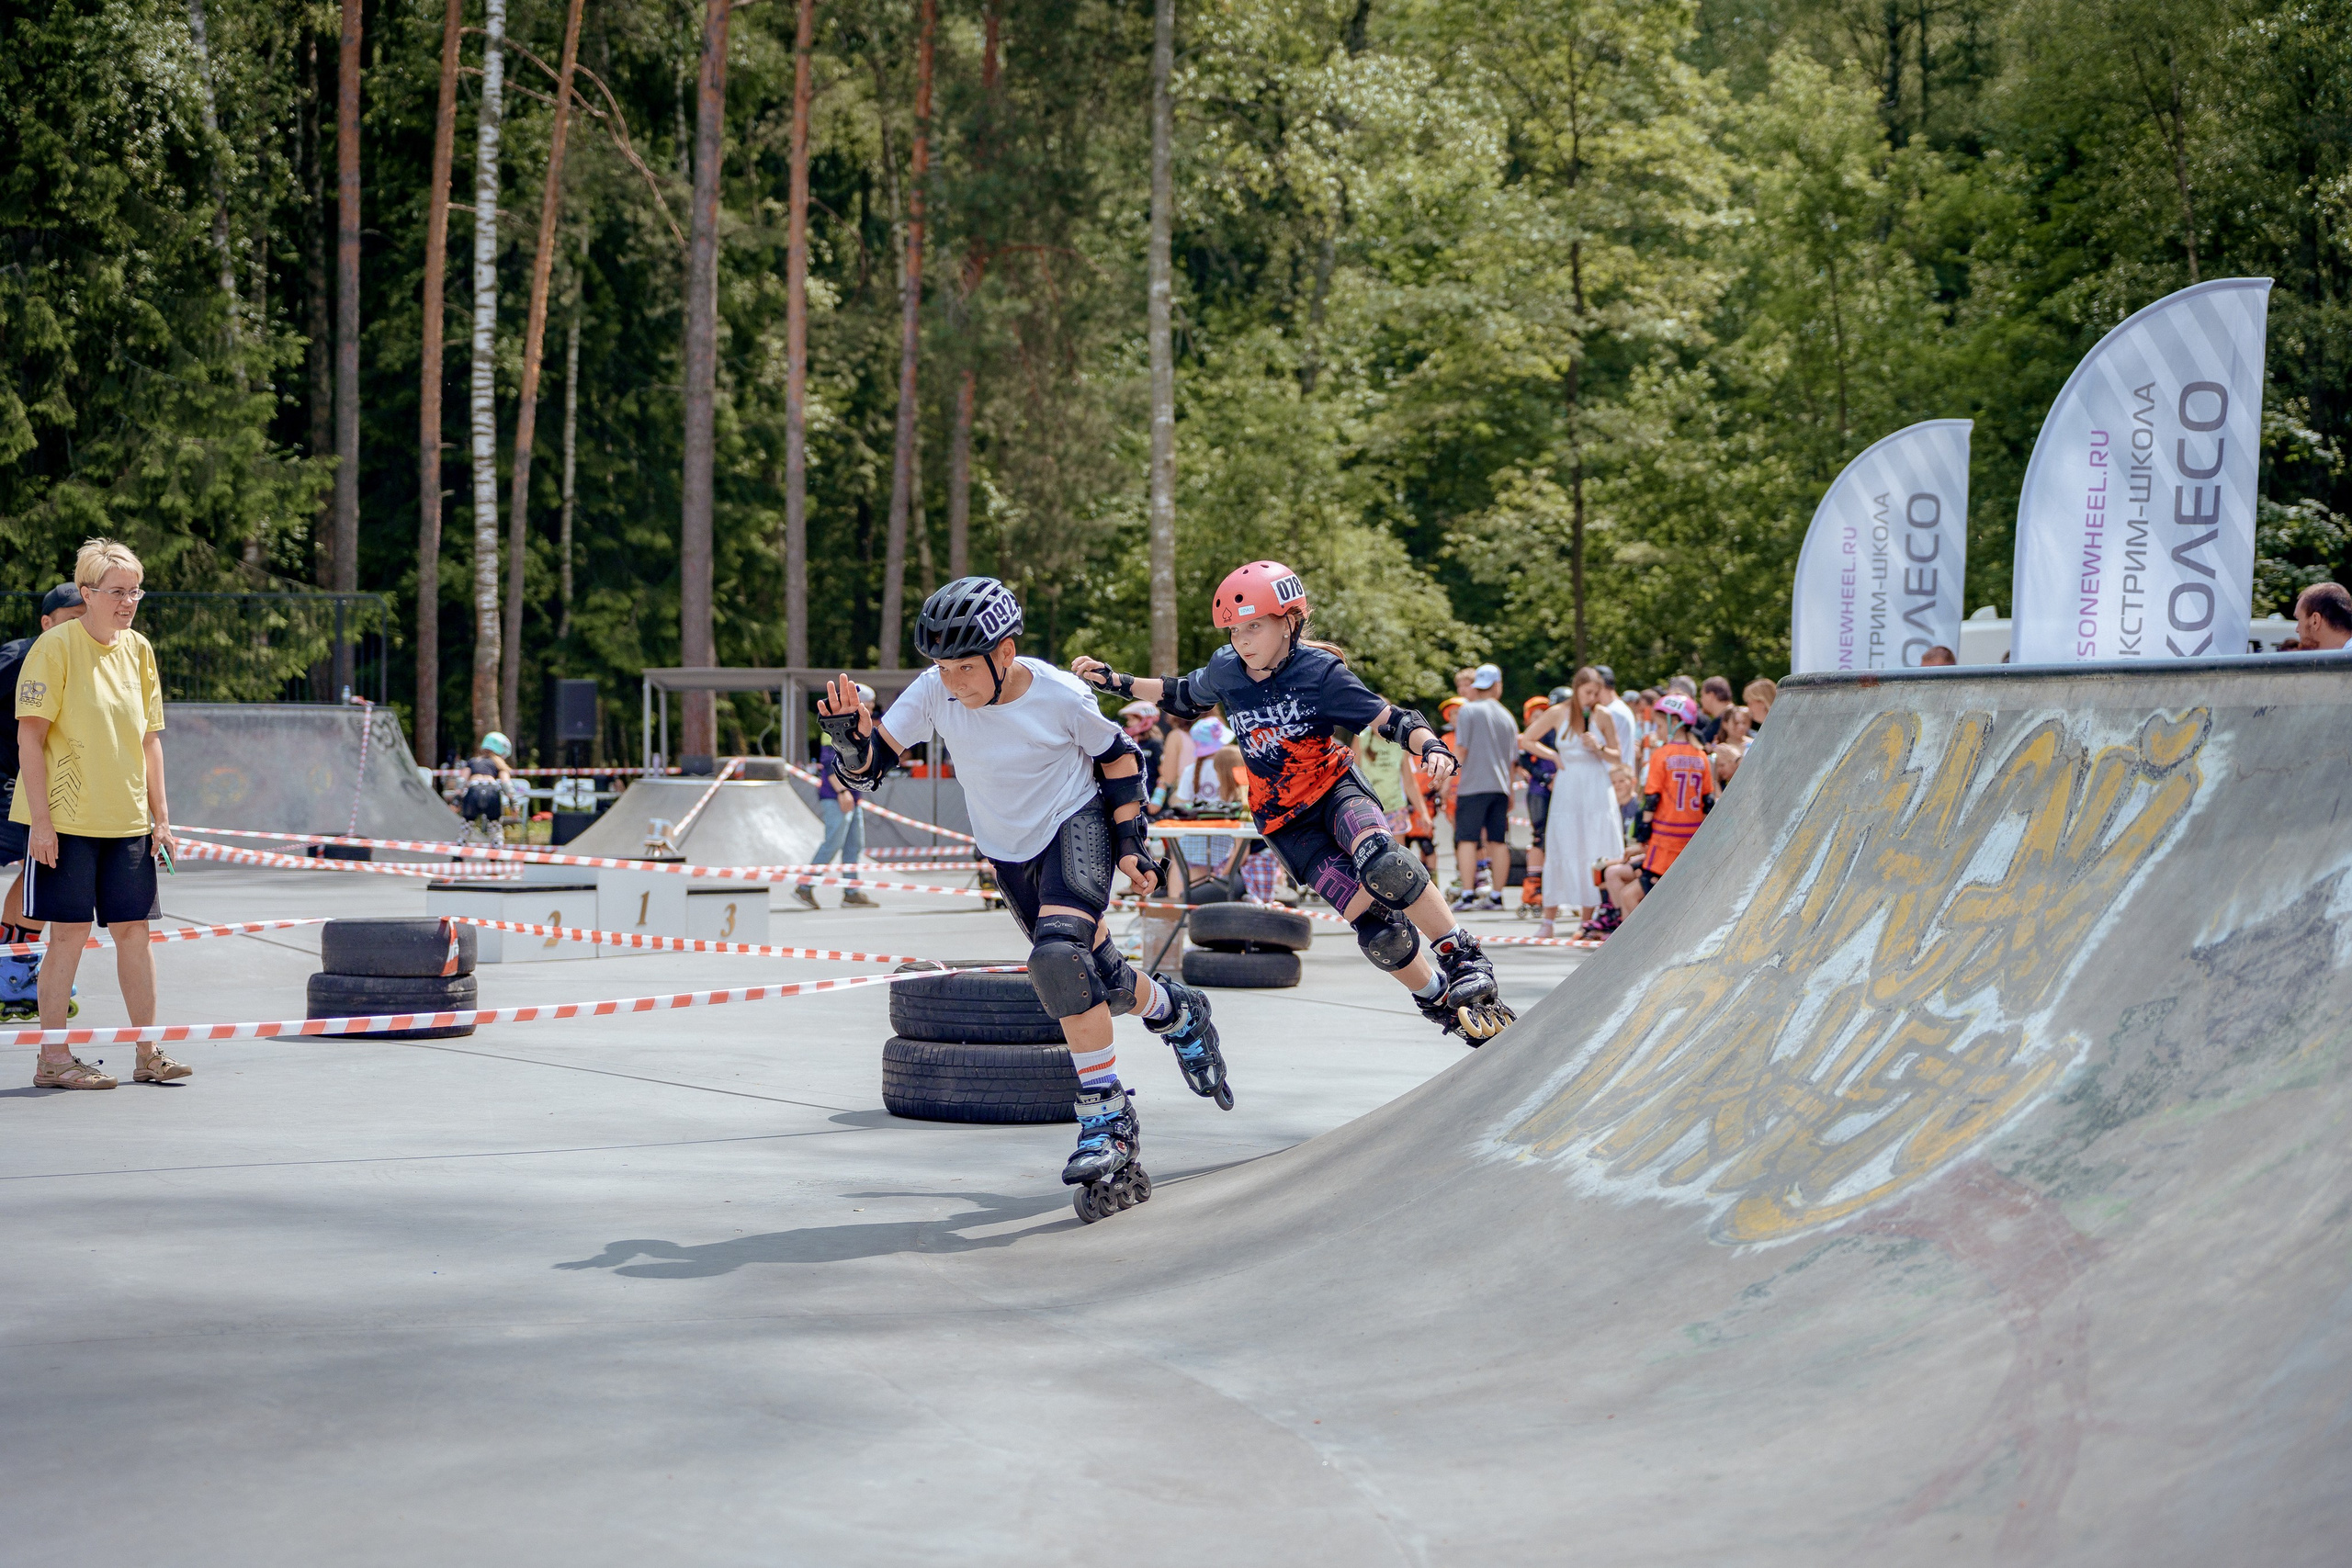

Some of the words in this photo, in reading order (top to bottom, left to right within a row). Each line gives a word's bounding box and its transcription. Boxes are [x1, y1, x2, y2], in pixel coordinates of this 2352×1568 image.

[2119, 381, 2156, 659] КСТРИМ-ШКОЛА
[2076, 430, 2109, 660] SONEWHEEL.RU
[1276, 576, 1304, 601] 078
[980, 593, 1018, 635] 092
[1672, 770, 1703, 812] 73
[1354, 839, 1374, 864] 187
[636, 890, 650, 927] 1
[720, 902, 738, 938] 3
[543, 909, 562, 948] 2
